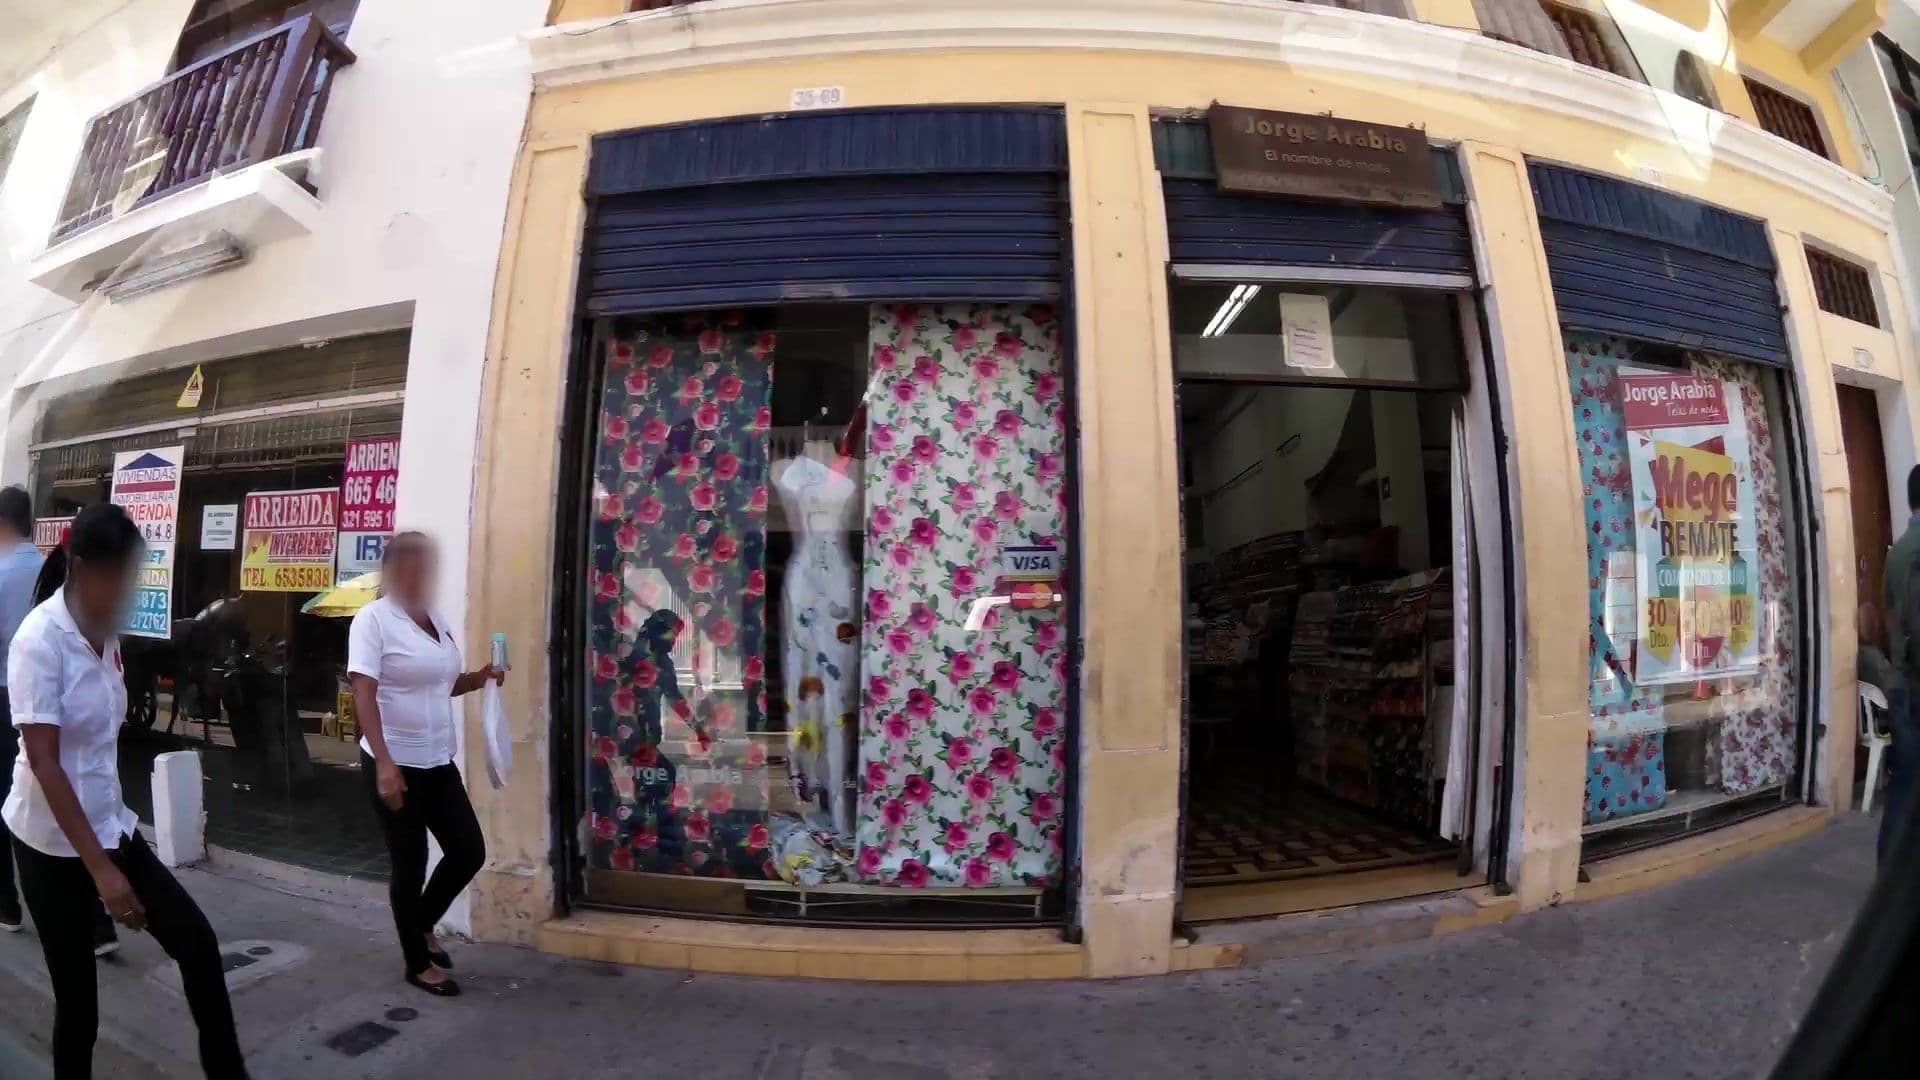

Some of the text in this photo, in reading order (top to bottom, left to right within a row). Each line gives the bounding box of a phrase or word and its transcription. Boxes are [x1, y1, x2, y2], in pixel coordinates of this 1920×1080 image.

[1244, 116, 1408, 153] Jorge Arabia
[1265, 150, 1279, 162] El
[1282, 152, 1333, 168] nombre
[1624, 380, 1717, 406] Jorge Arabia
[116, 467, 177, 483] VIVIENDAS
[1651, 455, 1737, 522] Mega
[344, 475, 372, 505] 665
[248, 493, 334, 528] ARRIENDA
[1660, 519, 1738, 557] REMATE
[1010, 555, 1051, 570] VISA
[244, 567, 270, 587] TEL.
